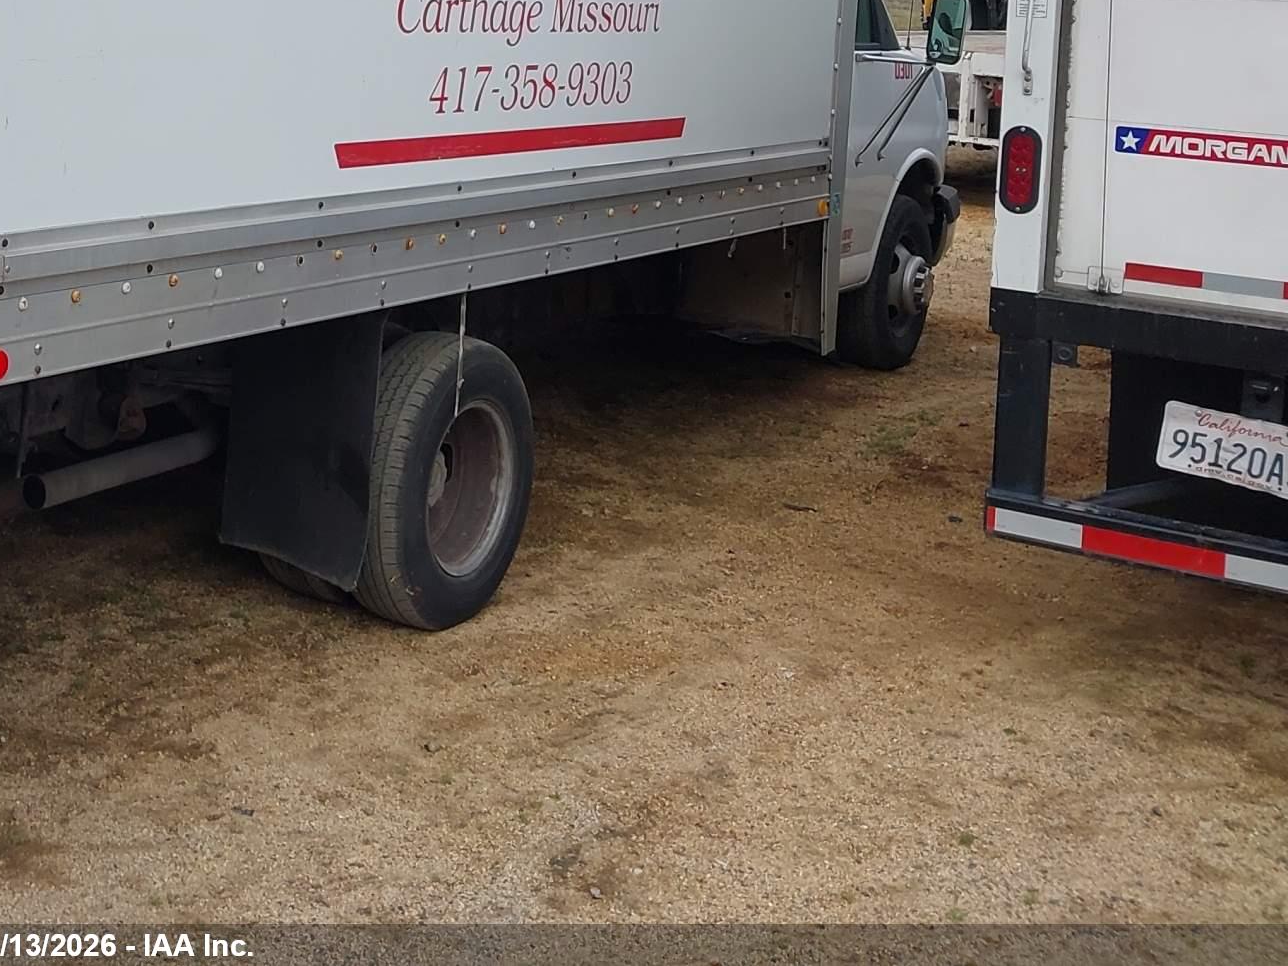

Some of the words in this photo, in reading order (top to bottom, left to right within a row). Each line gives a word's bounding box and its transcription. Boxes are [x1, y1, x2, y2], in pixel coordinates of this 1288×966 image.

[429, 61, 633, 115] 417-358-9303
[1148, 134, 1288, 165] MORGAN
[1198, 413, 1284, 444] California
[1168, 428, 1288, 486] 95120A
